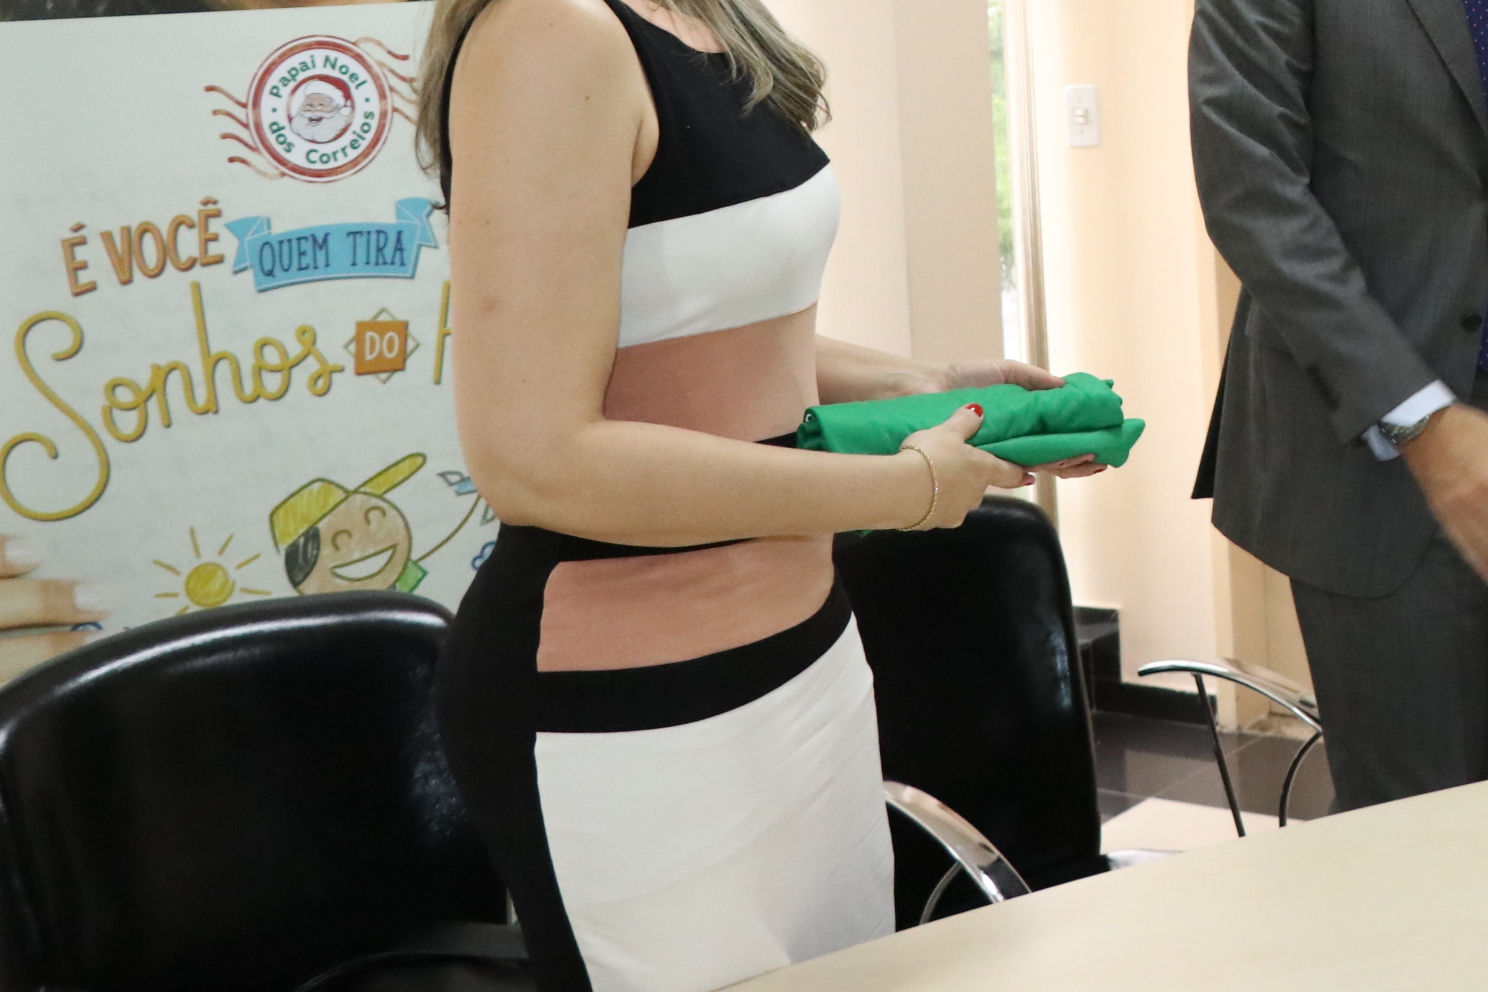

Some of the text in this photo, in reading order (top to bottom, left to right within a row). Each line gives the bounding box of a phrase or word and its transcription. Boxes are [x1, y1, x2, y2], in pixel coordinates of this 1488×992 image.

[269, 55, 368, 98] Papai Noel
[268, 110, 375, 165] dos Correios
[61, 196, 224, 296] É VOCÊ
[258, 229, 406, 278] QUEM TIRA
[0, 281, 344, 521] Sonhos
[365, 331, 399, 361] DO
